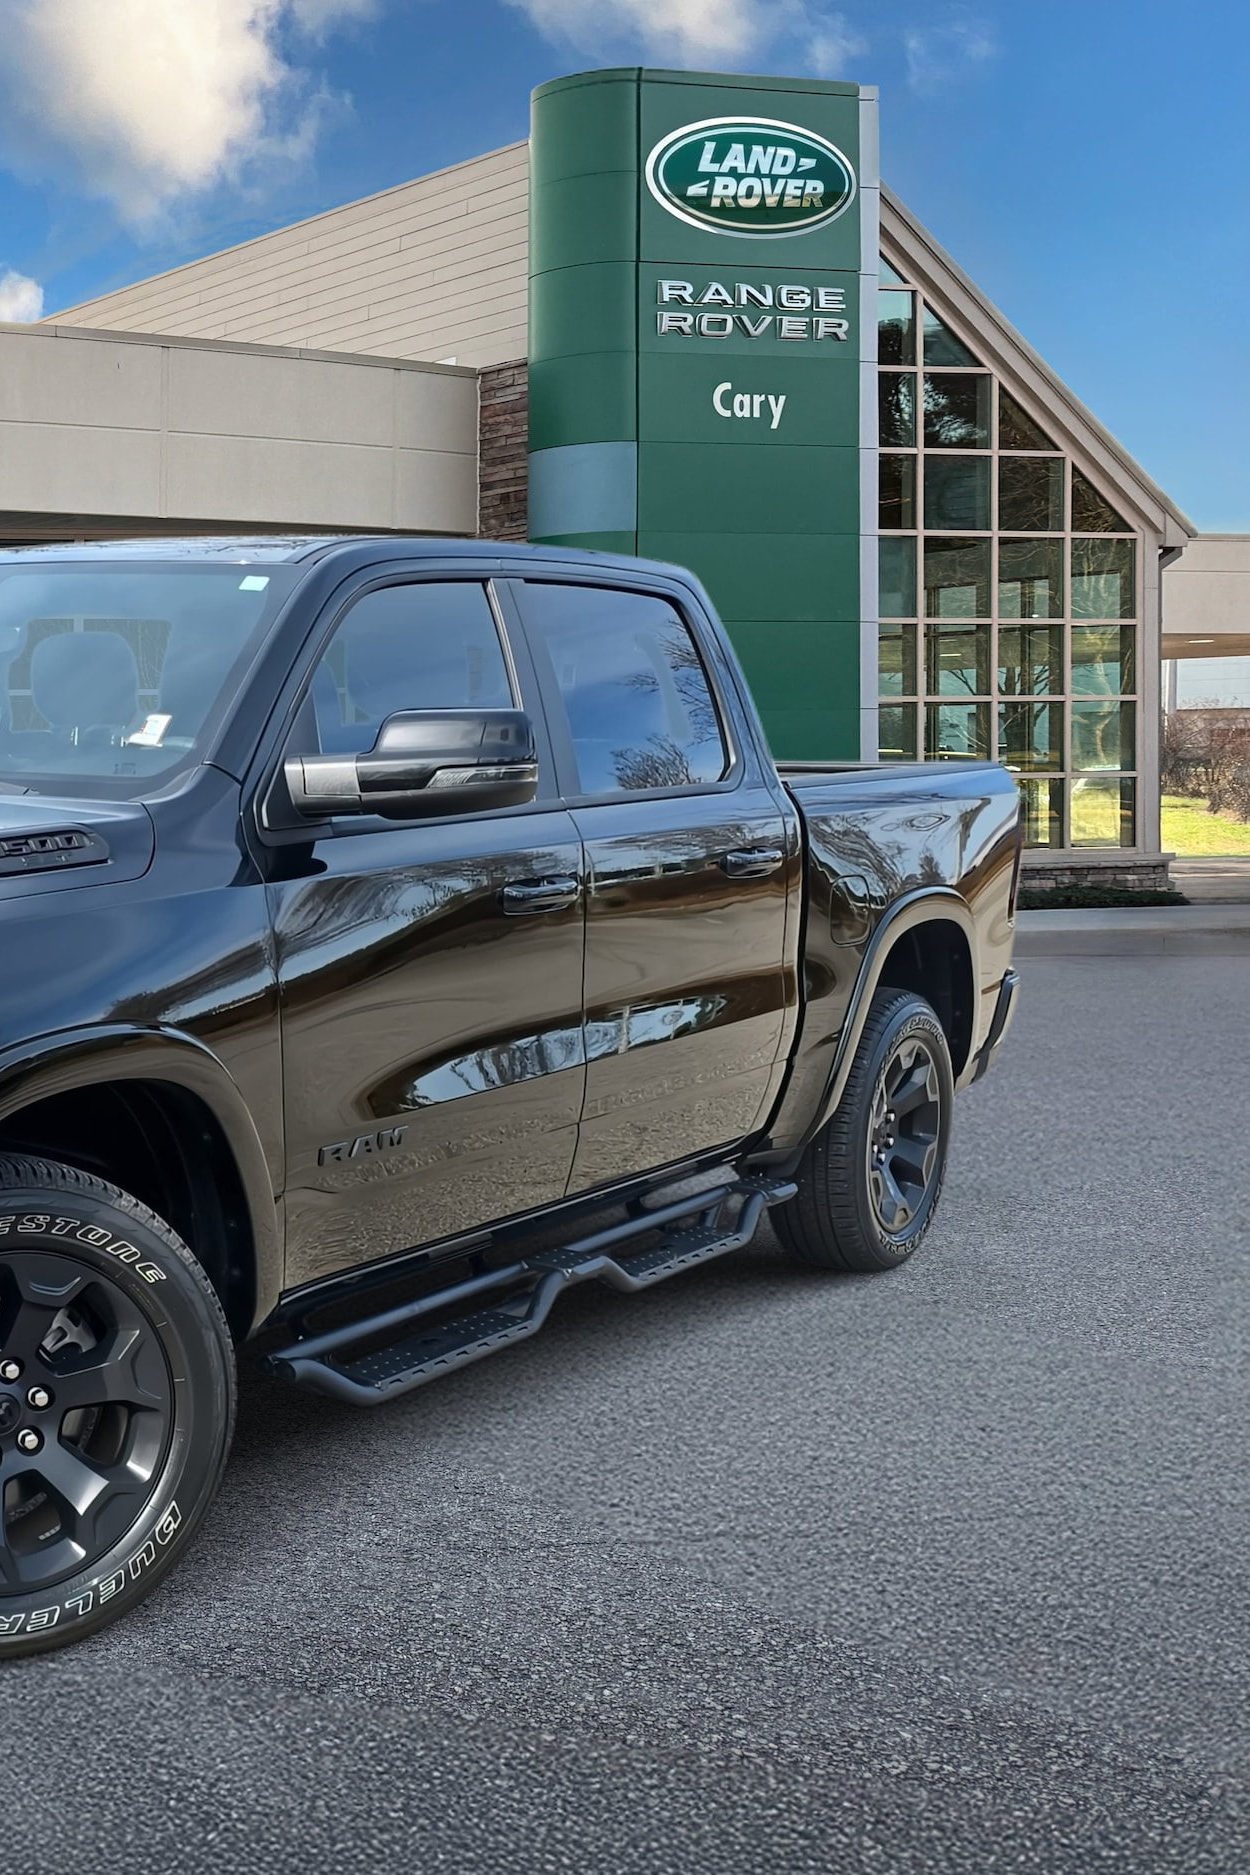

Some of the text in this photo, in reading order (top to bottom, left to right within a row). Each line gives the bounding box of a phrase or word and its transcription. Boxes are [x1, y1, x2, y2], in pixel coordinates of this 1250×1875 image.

[697, 141, 799, 175] LAND
[710, 176, 825, 208] ROVER
[657, 280, 847, 312] RANGE
[657, 312, 850, 342] ROVER
[712, 382, 787, 429] Cary
[317, 1125, 410, 1167] RAM
